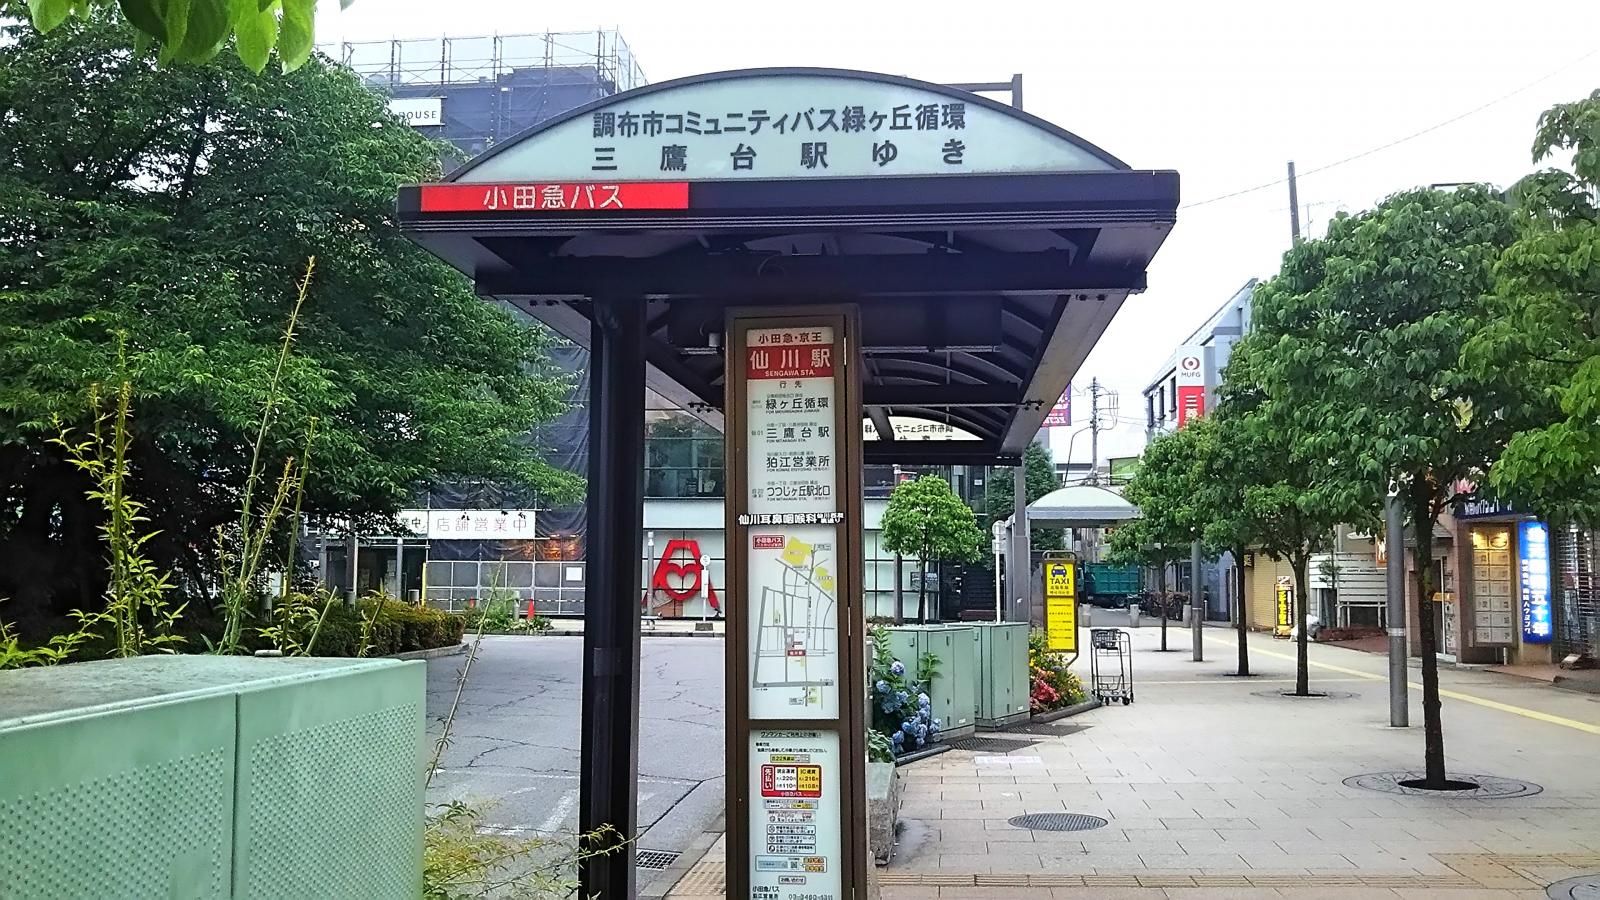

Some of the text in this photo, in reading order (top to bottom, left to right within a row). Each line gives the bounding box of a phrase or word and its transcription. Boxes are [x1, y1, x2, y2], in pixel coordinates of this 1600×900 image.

[593, 102, 966, 138] 調布市コミュニティバス緑ヶ丘循環
[592, 138, 966, 171] 三鷹台駅ゆき
[484, 185, 623, 210] 小田急バス
[750, 348, 831, 370] 仙川駅
[766, 397, 828, 410] 緑ヶ丘循環
[767, 426, 830, 439] 三鷹台駅
[767, 455, 830, 468] 狛江営業所
[767, 485, 831, 497] つつじヶ丘駅北口
[436, 517, 527, 532] 店舗営業中
